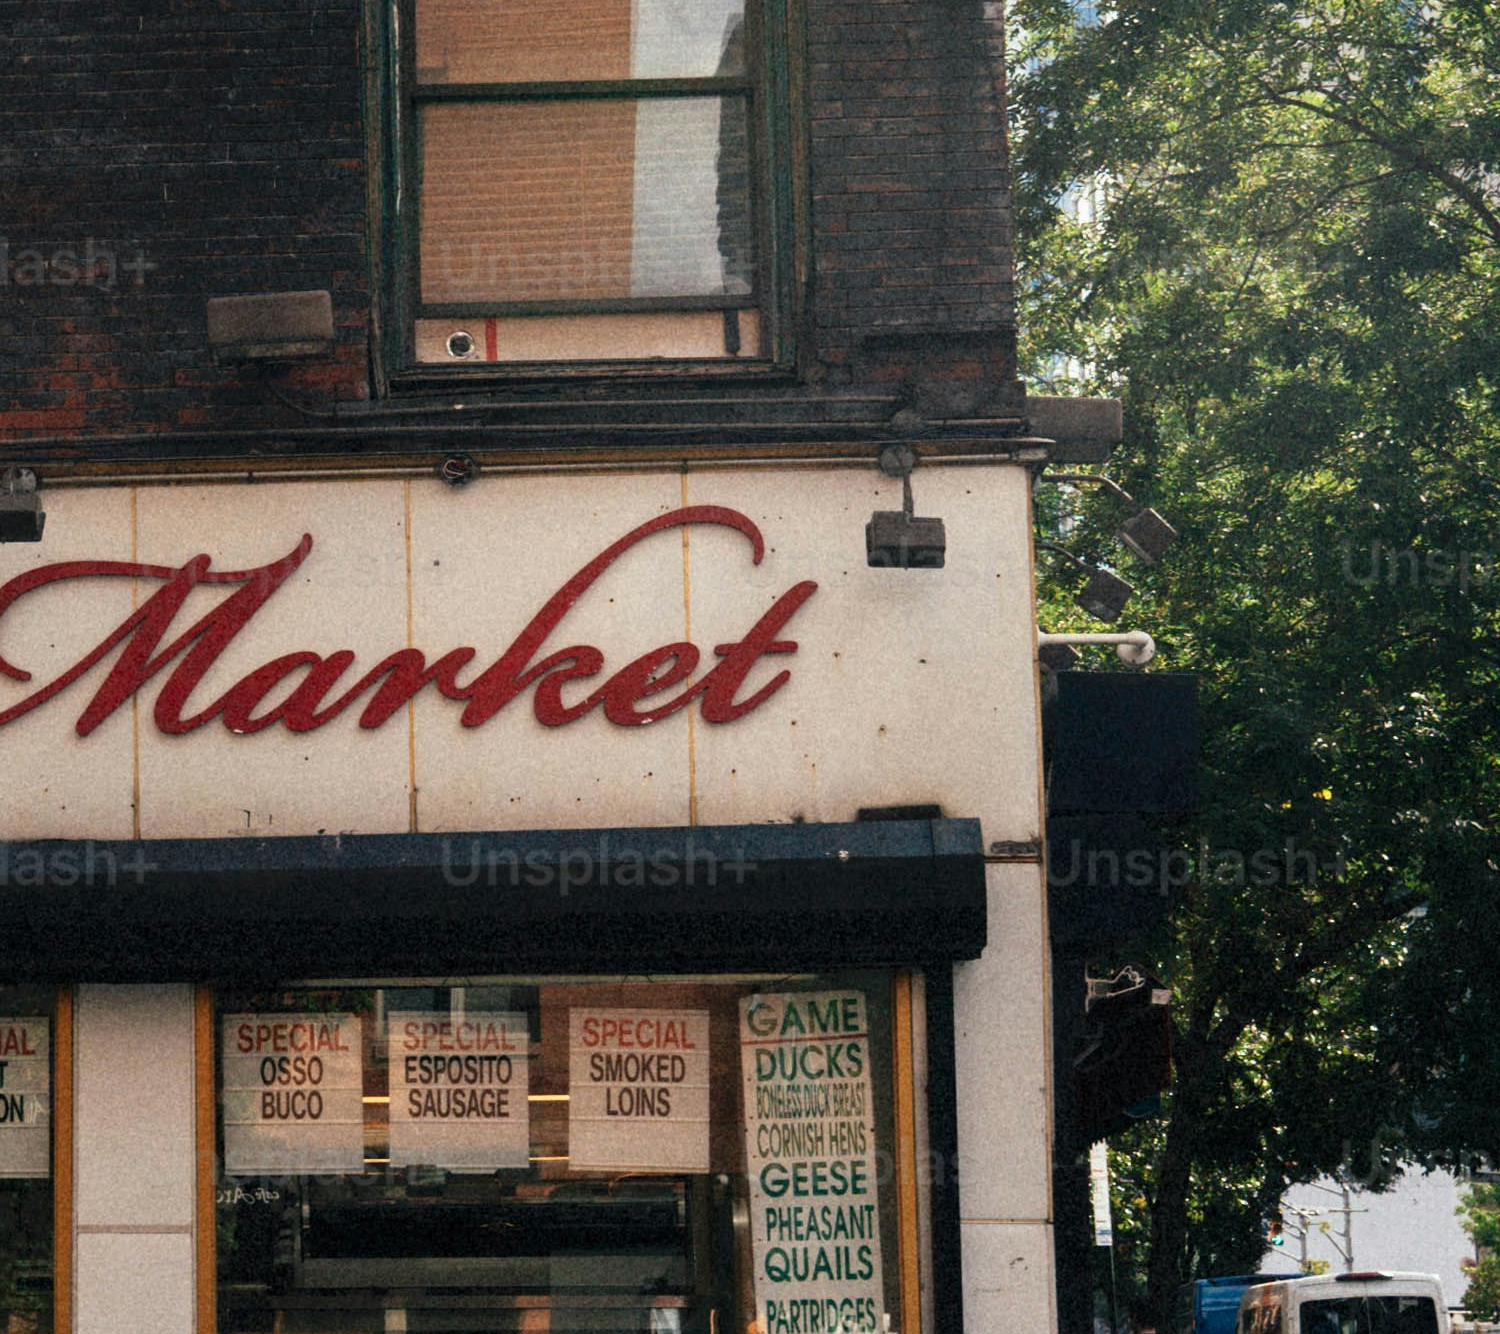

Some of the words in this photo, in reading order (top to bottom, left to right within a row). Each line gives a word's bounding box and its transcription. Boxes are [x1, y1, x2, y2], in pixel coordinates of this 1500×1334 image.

[746, 998, 859, 1036] GAME
[236, 1022, 350, 1054] SPECIAL
[402, 1020, 517, 1051] SPECIAL
[581, 1018, 696, 1049] SPECIAL
[259, 1056, 324, 1086] OSSO
[403, 1055, 513, 1085] ESPOSITO
[589, 1054, 686, 1083] SMOKED
[755, 1042, 864, 1081] DUCKS
[260, 1090, 324, 1121] BUCO
[407, 1088, 511, 1119] SAUSAGE
[605, 1088, 671, 1118] LOINS
[756, 1082, 800, 1120] BONELESS
[802, 1081, 830, 1119] DUCK
[832, 1081, 866, 1118] BREAST
[756, 1123, 825, 1159] CORNISH
[829, 1122, 867, 1158] HENS
[760, 1161, 868, 1198] GEESE
[765, 1203, 875, 1243] PHEASANT
[764, 1246, 874, 1284] QUAILS
